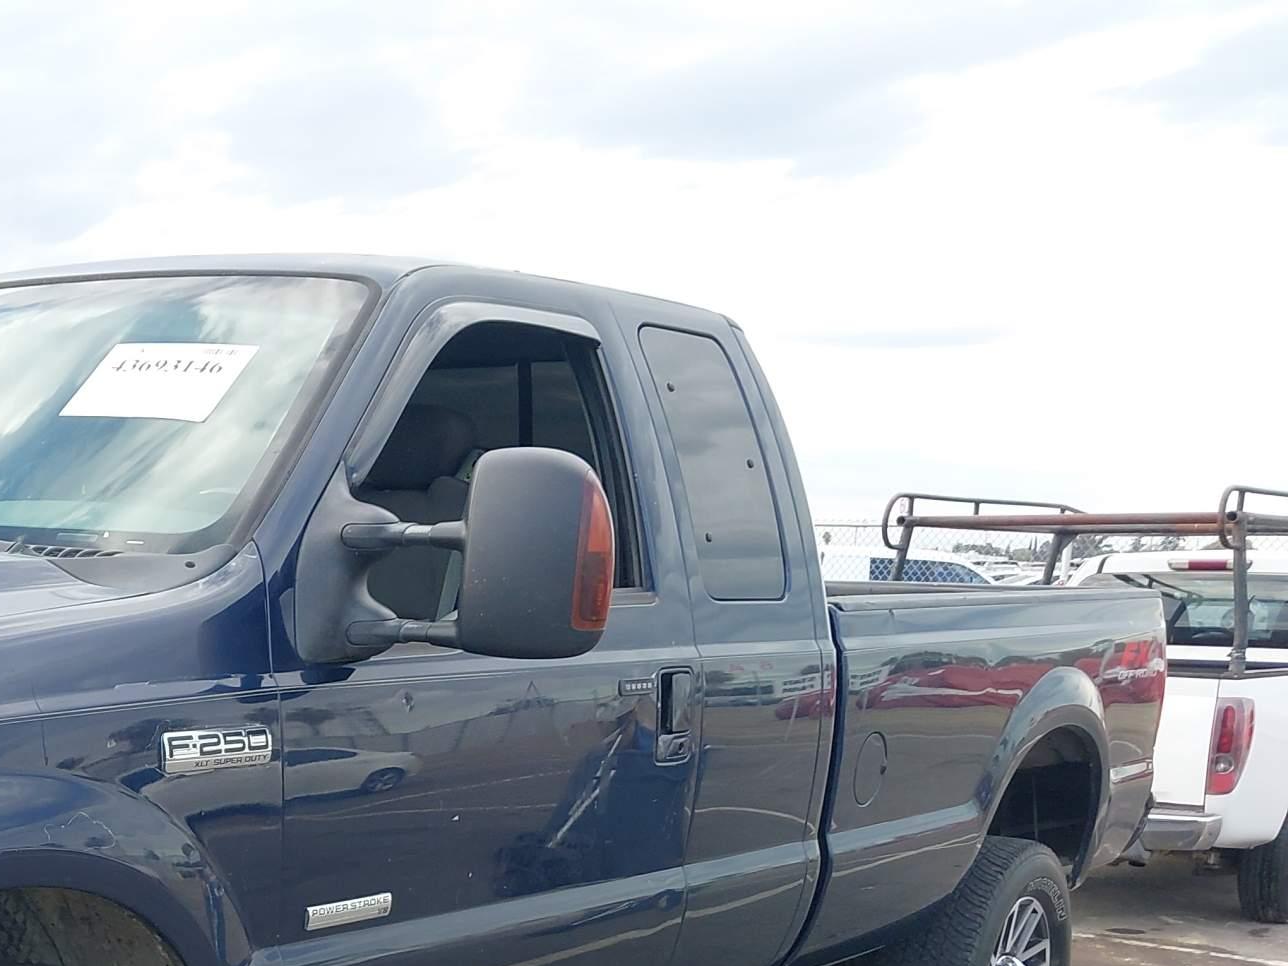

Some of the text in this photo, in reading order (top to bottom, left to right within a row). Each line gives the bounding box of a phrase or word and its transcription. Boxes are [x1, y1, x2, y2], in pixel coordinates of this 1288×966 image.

[167, 729, 269, 759] F-250
[194, 754, 268, 768] XLT SUPER DUTY
